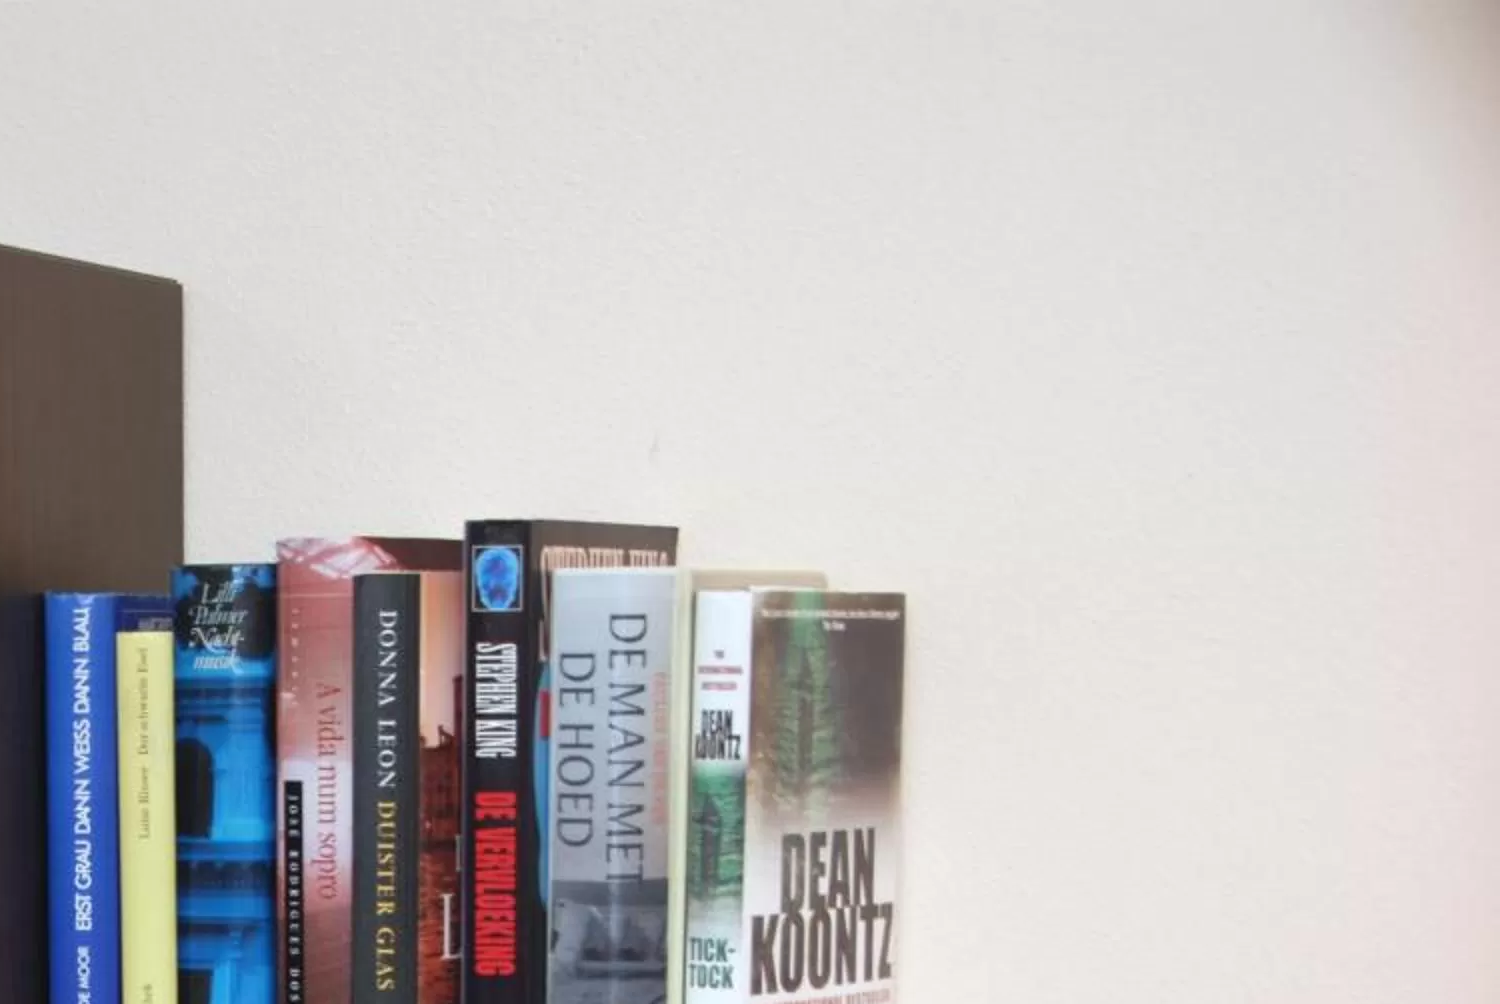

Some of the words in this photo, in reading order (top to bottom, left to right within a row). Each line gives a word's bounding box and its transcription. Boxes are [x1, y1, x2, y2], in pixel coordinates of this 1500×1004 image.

[73, 605, 91, 652] BLAU
[608, 613, 648, 670] DE
[73, 658, 91, 714] DANN
[378, 609, 398, 708] DONNA
[475, 642, 517, 714] STEPHEN
[559, 652, 596, 707] DE
[316, 683, 340, 699] A
[74, 719, 91, 773] WEISS
[317, 705, 344, 758] vida
[475, 718, 517, 759] KING
[607, 682, 646, 788] MAN
[695, 734, 741, 760] KOONTZ
[701, 709, 733, 736] DEAN
[377, 718, 397, 790] LEON
[74, 779, 91, 835] DANN
[317, 765, 337, 824] num
[475, 791, 517, 820] DE
[557, 723, 594, 847] HOED
[75, 841, 92, 890] GRAU
[310, 832, 337, 901] sopro
[376, 800, 396, 917] DUISTER
[605, 802, 645, 883] MET
[781, 828, 875, 910] DEAN
[76, 894, 93, 931] ERST
[475, 826, 517, 976] VERVLOEKING
[376, 926, 395, 992] GLAS
[689, 964, 734, 989] TOCK
[690, 937, 736, 963] TICK-
[751, 903, 893, 995] KOONTZ
[289, 967, 300, 1003] DOS
